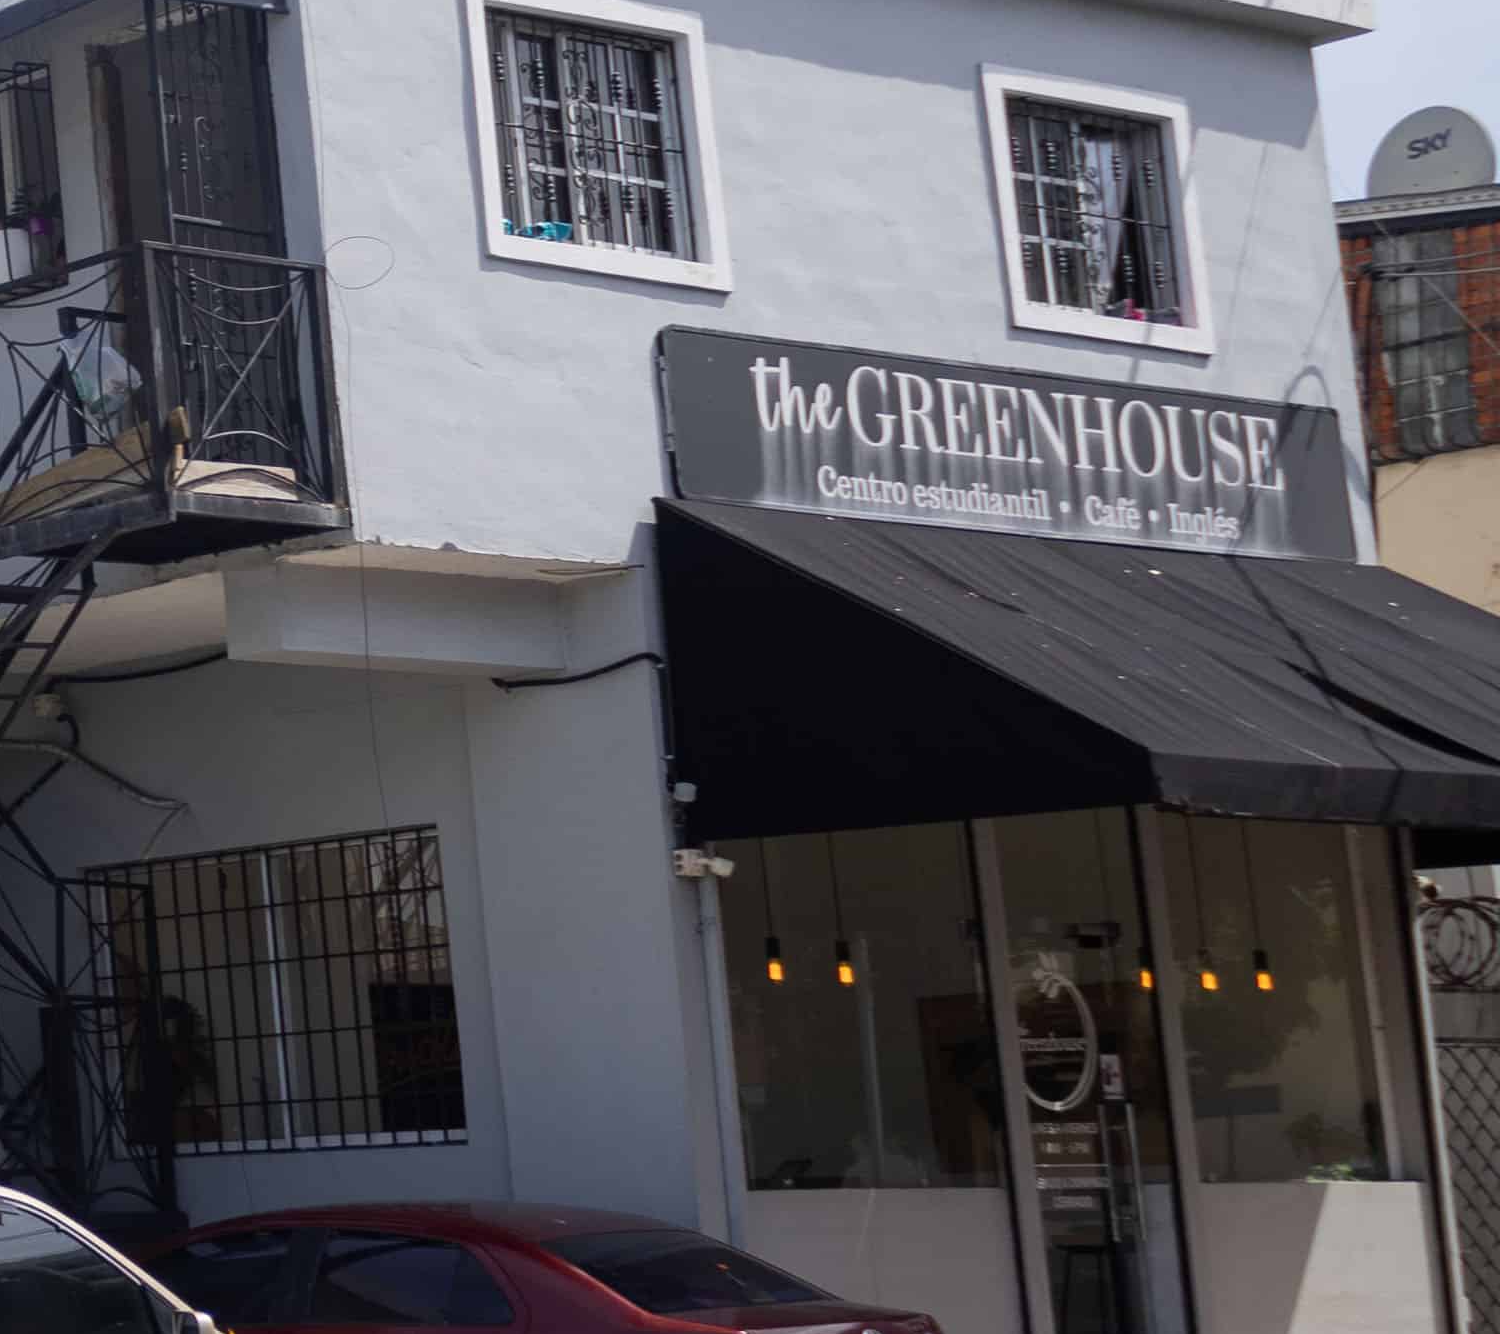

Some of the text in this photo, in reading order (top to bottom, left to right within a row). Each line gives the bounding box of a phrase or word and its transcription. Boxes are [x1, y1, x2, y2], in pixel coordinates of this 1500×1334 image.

[1406, 128, 1452, 159] SKY
[749, 357, 1285, 492] the GREENHOUSE
[817, 465, 1241, 545] Centro estudiantil Café Inglés
